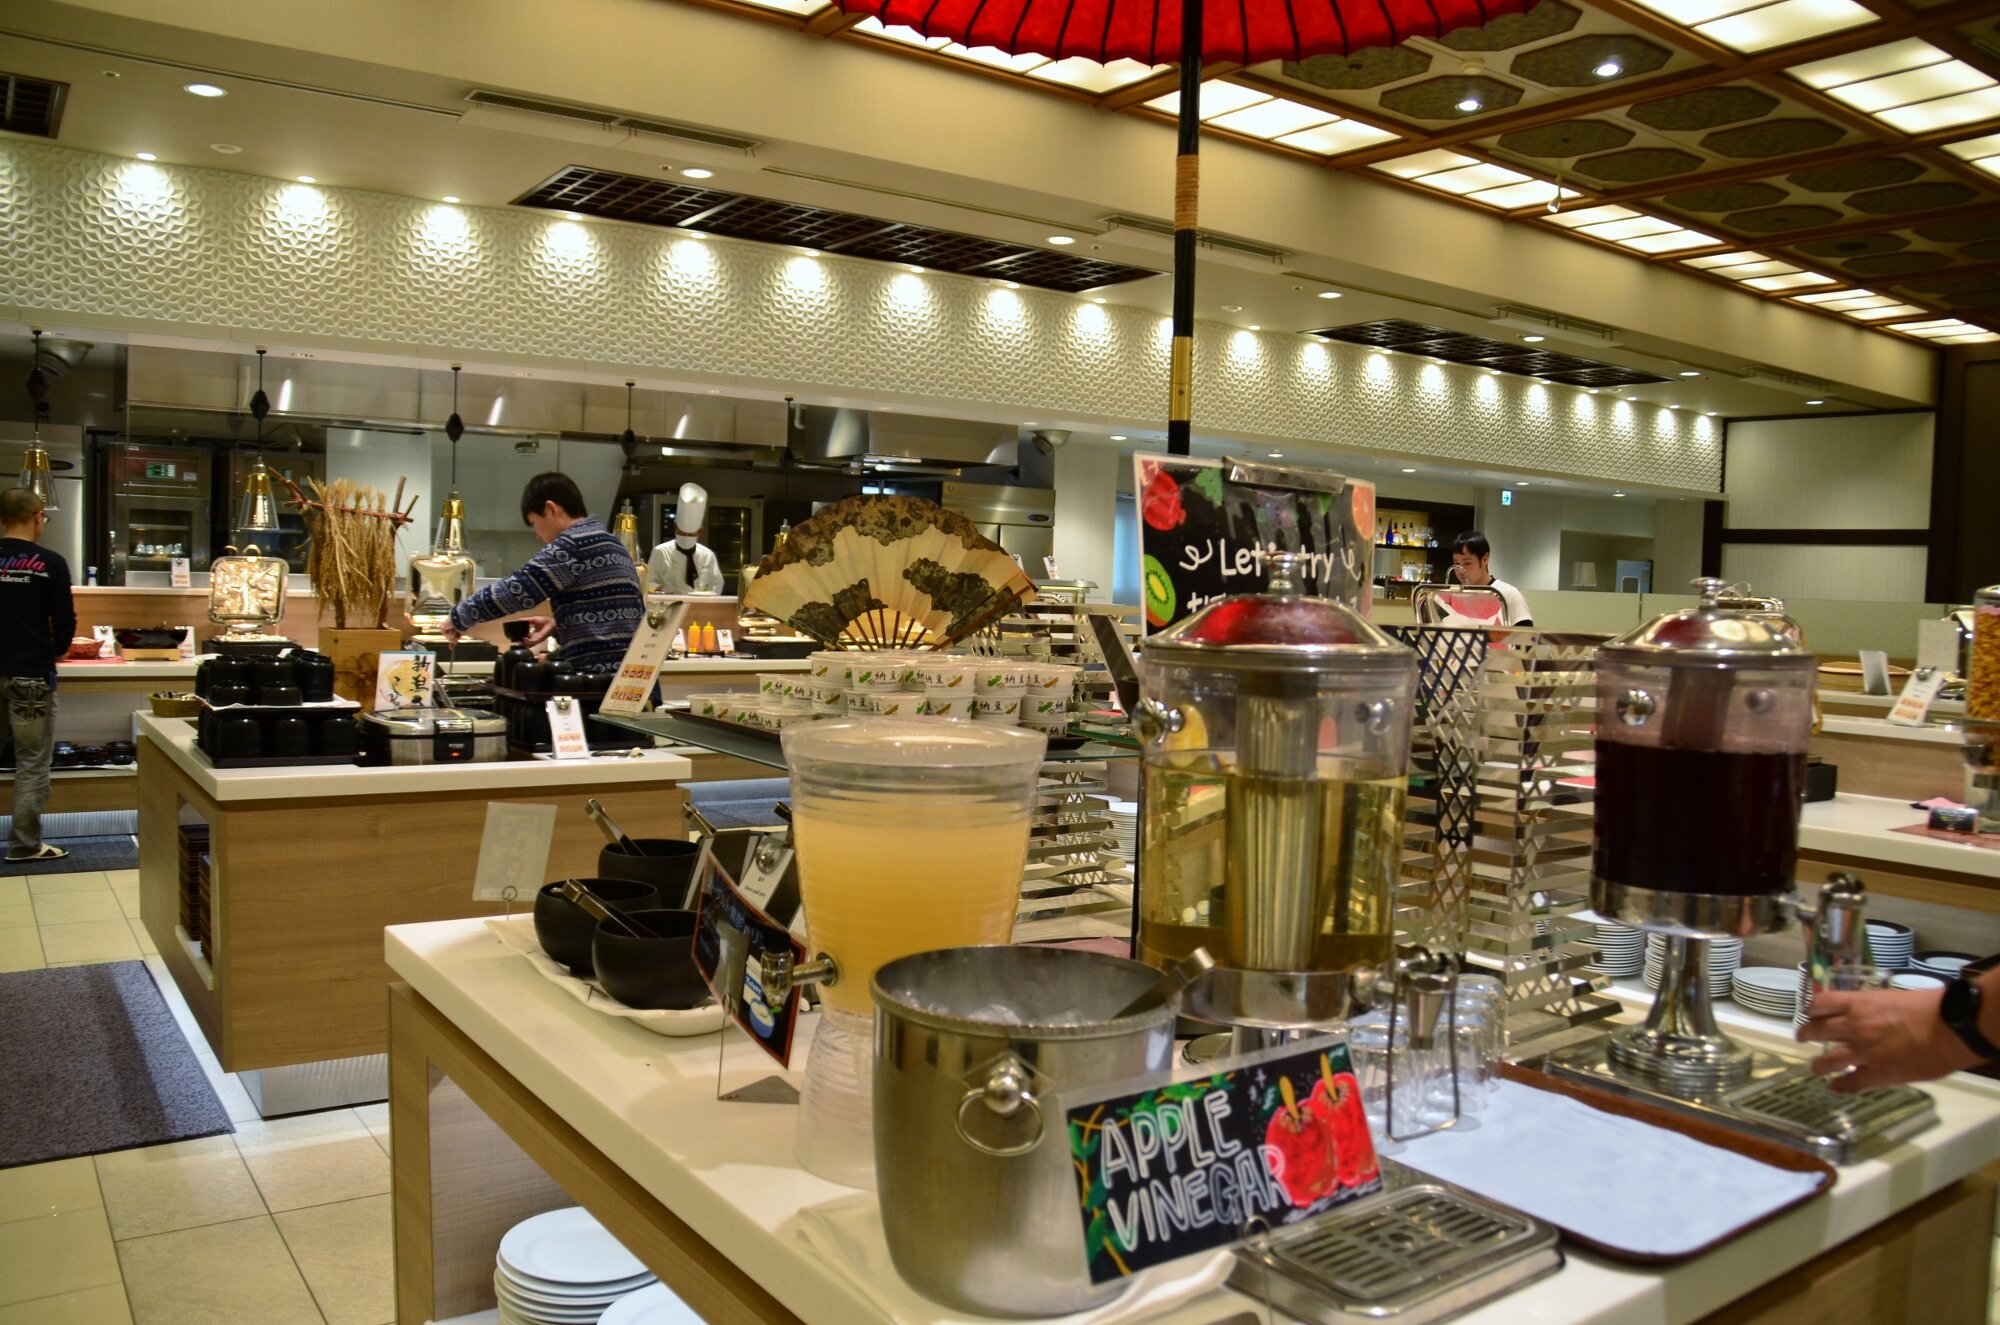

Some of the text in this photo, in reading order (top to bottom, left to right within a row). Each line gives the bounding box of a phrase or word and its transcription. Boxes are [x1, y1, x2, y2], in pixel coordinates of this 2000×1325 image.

[1299, 544, 1335, 583] try
[1101, 1090, 1241, 1190] APPLE
[1106, 1145, 1292, 1252] VINEGAR
